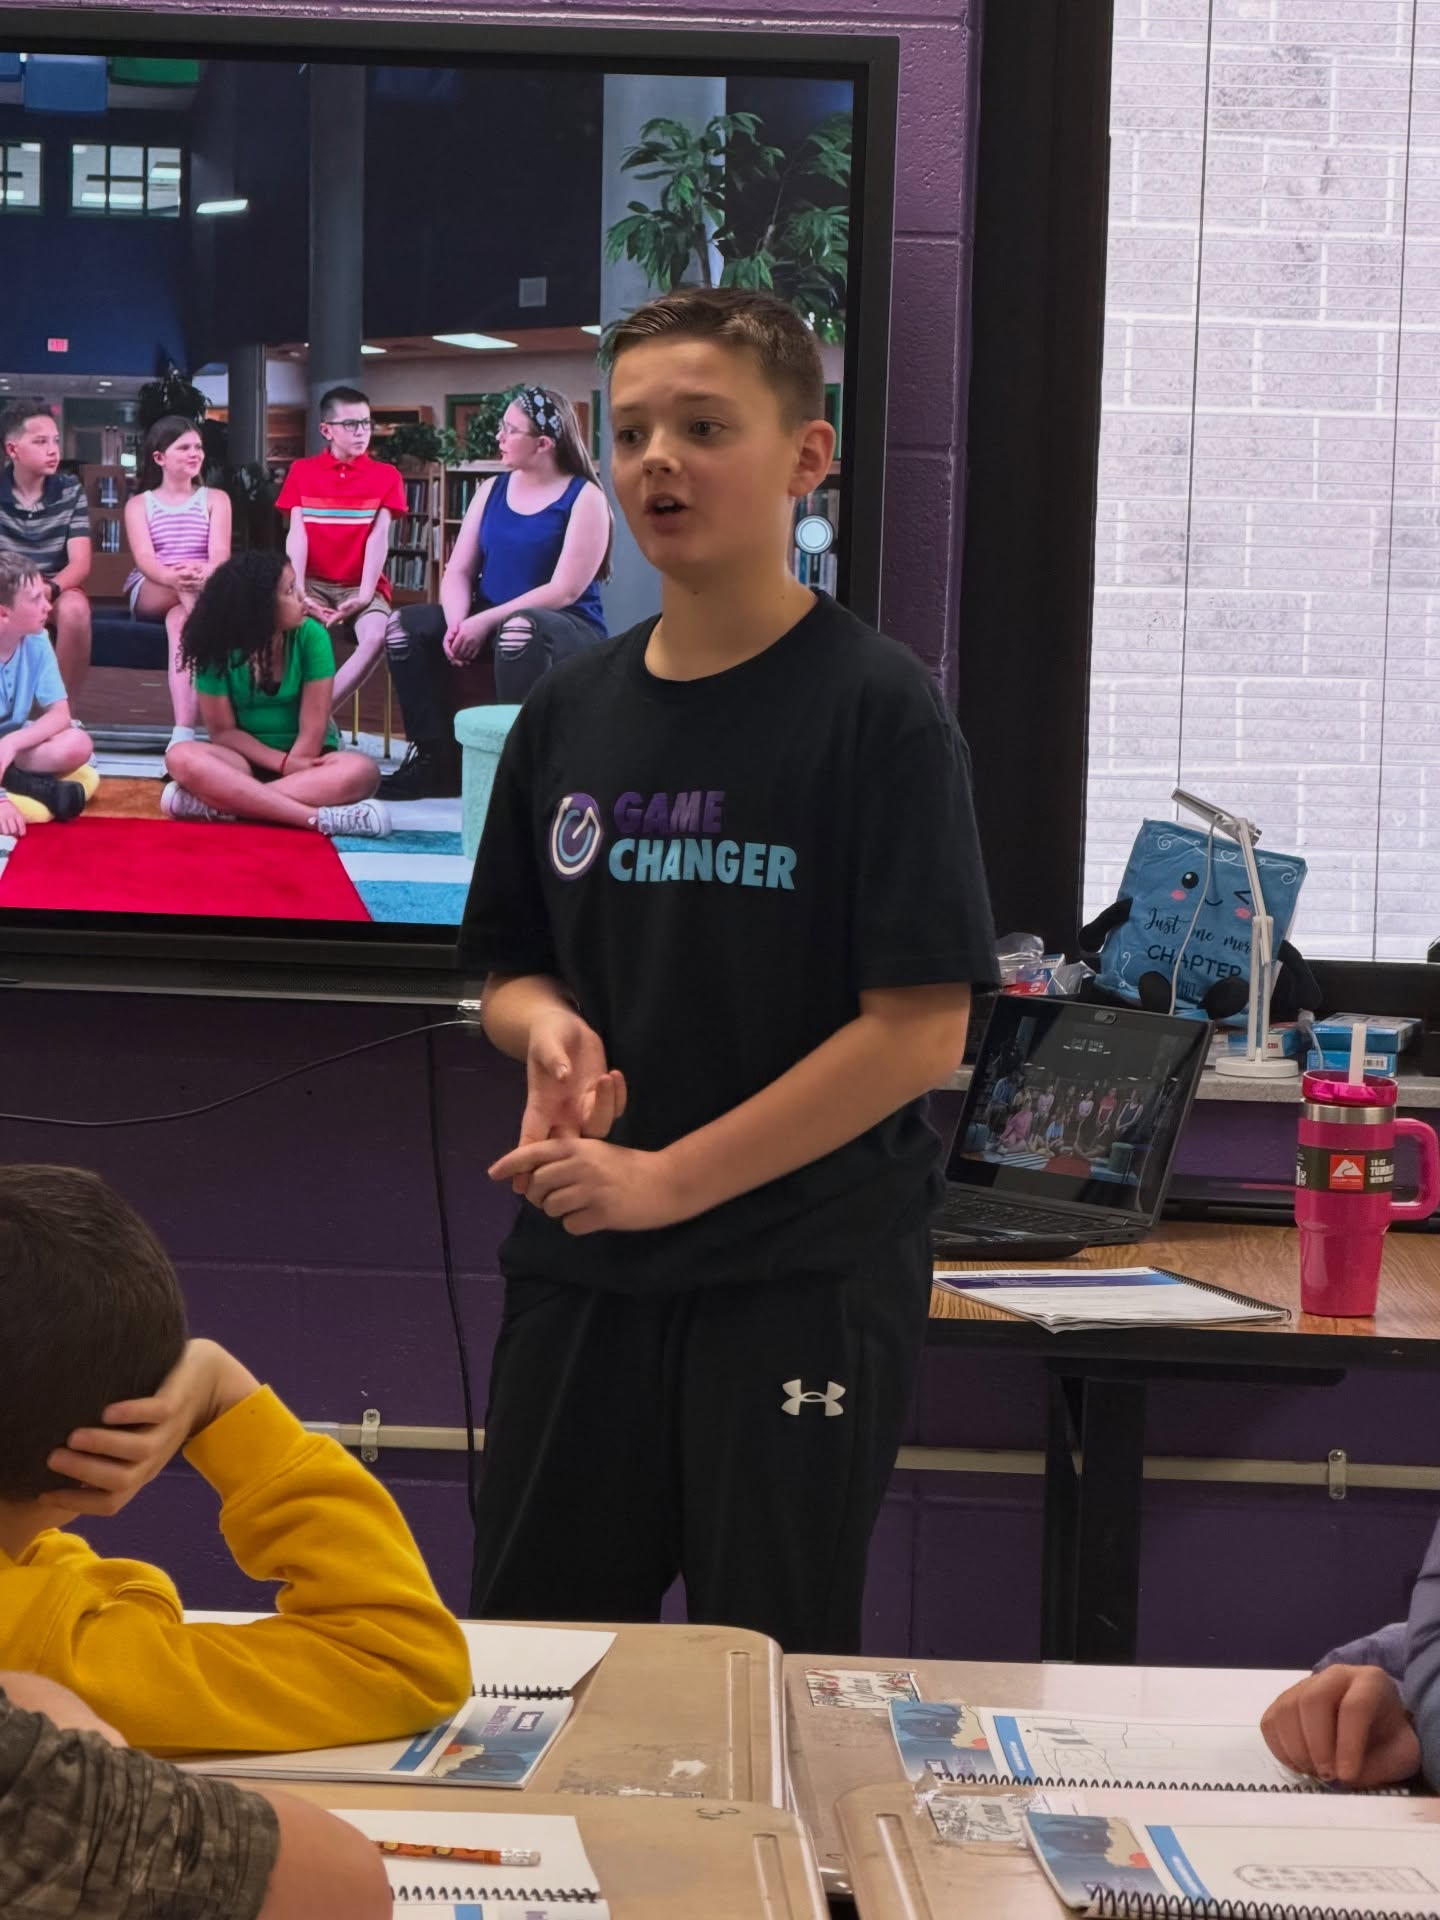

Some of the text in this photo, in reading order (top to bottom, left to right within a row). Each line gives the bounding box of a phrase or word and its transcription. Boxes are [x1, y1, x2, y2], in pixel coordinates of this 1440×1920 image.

[613, 790, 726, 834] GAME
[608, 837, 798, 890] CHANGER
[1143, 907, 1191, 935] Just
[1222, 935, 1253, 954] mor
